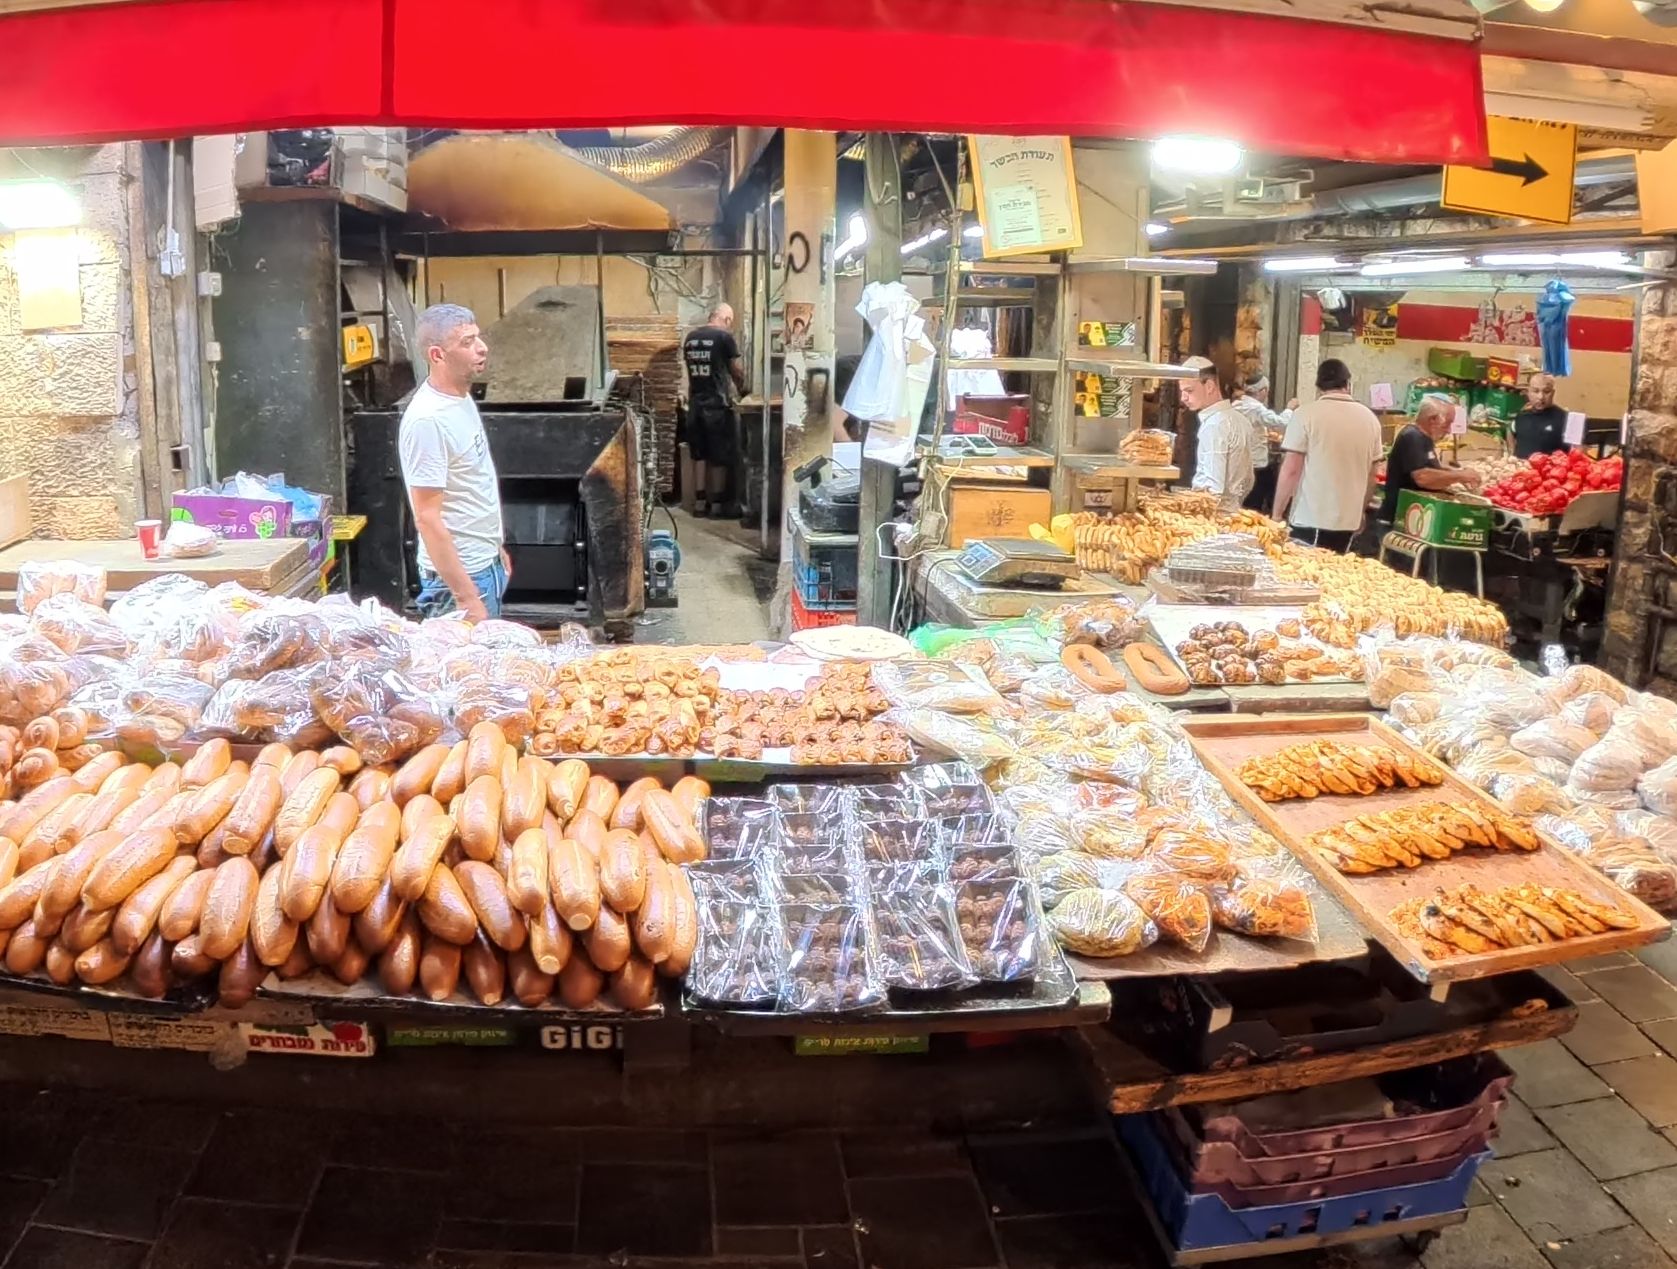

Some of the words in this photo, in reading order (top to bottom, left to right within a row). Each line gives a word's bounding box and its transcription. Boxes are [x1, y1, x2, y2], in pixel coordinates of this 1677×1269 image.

[990, 153, 1020, 168] הכשר
[1021, 150, 1054, 162] תעודת
[320, 1038, 367, 1053] פירות
